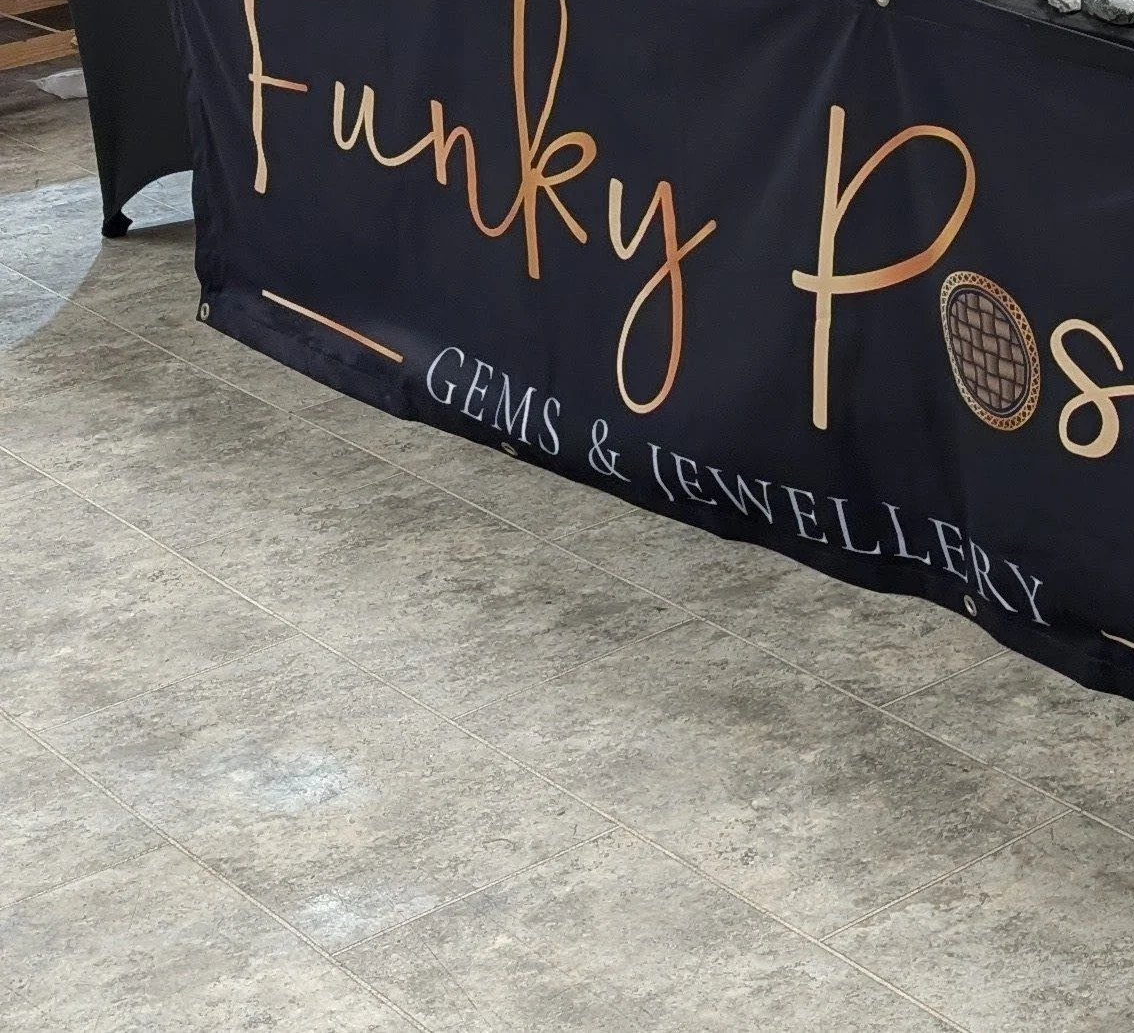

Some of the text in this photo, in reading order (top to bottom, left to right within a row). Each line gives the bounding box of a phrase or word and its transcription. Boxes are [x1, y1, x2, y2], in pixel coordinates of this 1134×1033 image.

[425, 345, 1052, 627] GEMS & JEWELLERY
